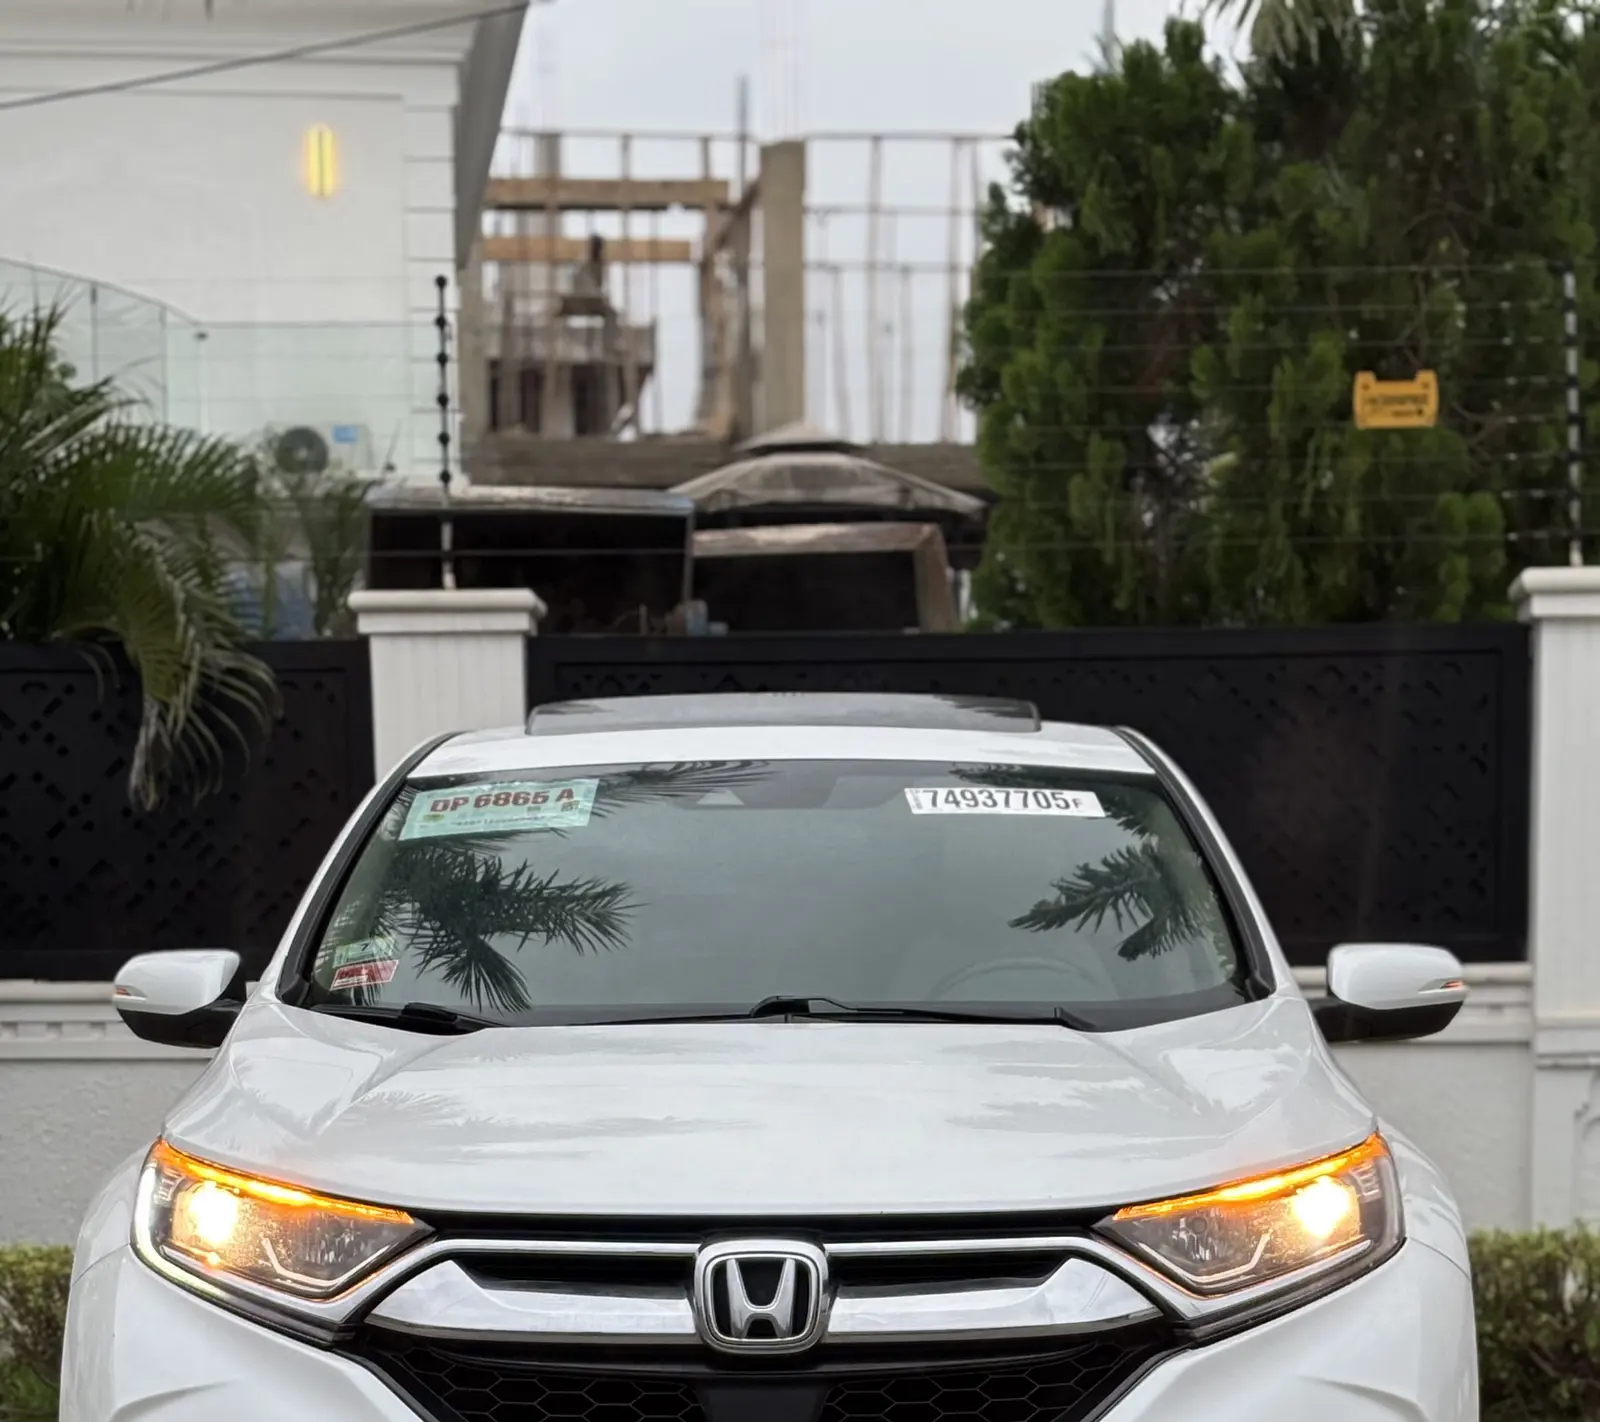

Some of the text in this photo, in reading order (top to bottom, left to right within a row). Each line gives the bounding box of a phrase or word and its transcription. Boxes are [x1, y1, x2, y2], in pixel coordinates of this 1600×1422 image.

[430, 787, 576, 813] DP 6865 A
